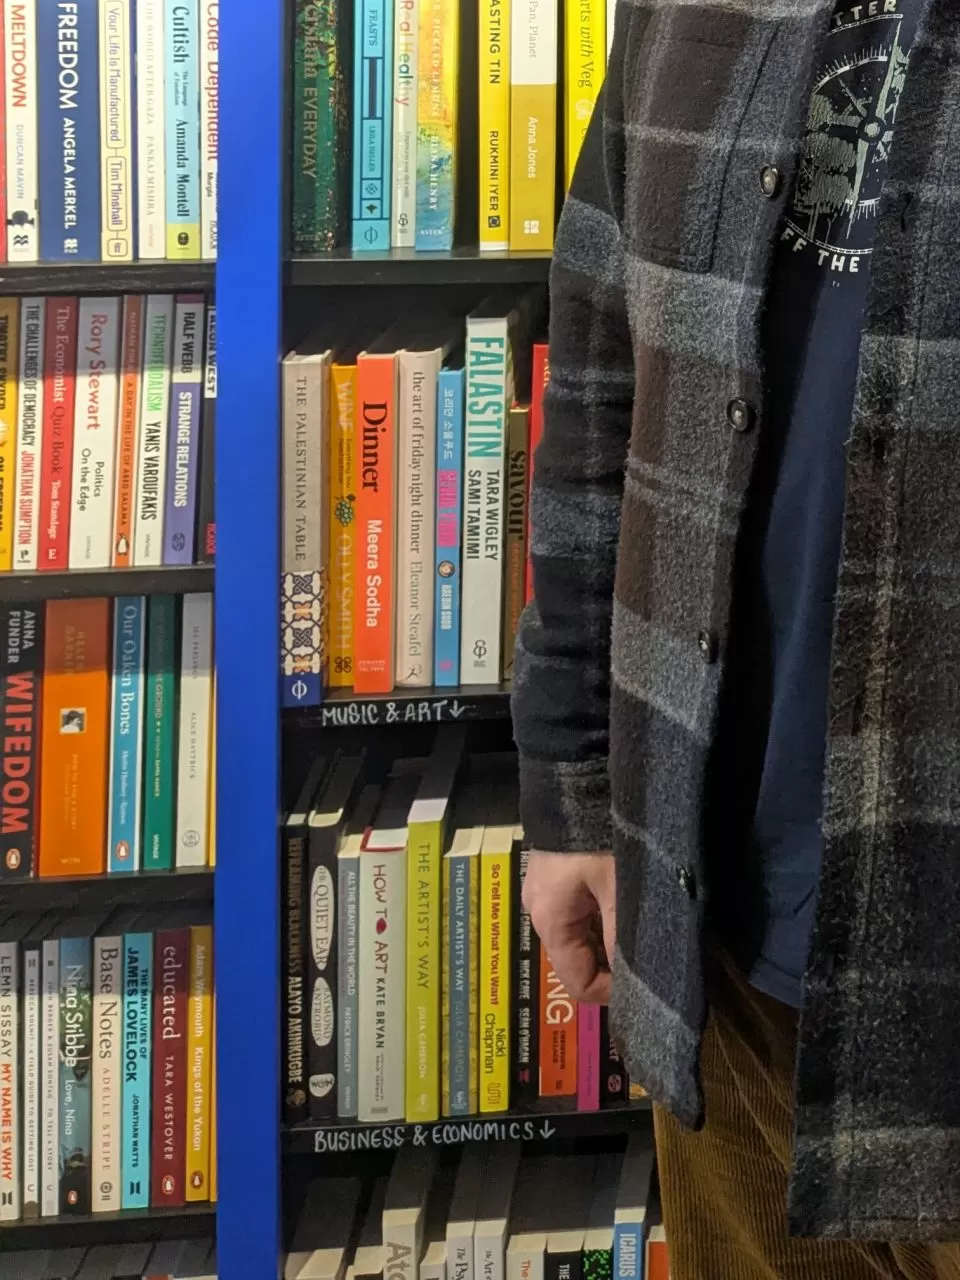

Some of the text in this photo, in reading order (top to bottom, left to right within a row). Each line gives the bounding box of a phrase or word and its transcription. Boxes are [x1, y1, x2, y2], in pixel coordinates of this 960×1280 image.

[12, 5, 26, 108] MELTDOWN
[173, 6, 189, 63] Cultish
[489, 59, 500, 84] TIN
[57, 3, 78, 229] FREEDOM ANGELA MERKEL
[176, 118, 190, 217] Amanda Montell
[817, 250, 859, 273] THE
[86, 314, 107, 430] Rory Stewart
[468, 337, 504, 457] FALASTIN
[82, 449, 91, 464] On
[94, 461, 104, 497] Politics
[174, 392, 192, 507] STRANGE RELATIONS
[79, 486, 90, 511] Edge
[362, 401, 388, 627] Dinner Meera Sodha
[467, 470, 481, 560] SAMI TAMIMI
[486, 470, 499, 561] TARA WIGLEY
[8, 611, 20, 664] FUNDER
[23, 610, 35, 649] ANNA
[0, 672, 33, 834] WIFEDOM
[322, 700, 447, 726] MUSIC & ART
[417, 842, 431, 990] THE ARTIST'S WAY
[100, 948, 118, 1060] Base Notes
[126, 948, 138, 1082] JAMES LOVELOCK
[162, 946, 180, 1040] educated
[1, 1064, 12, 1180] MY NAME IS WHY
[314, 1124, 534, 1152] BUSINESS & ECONOMICS
